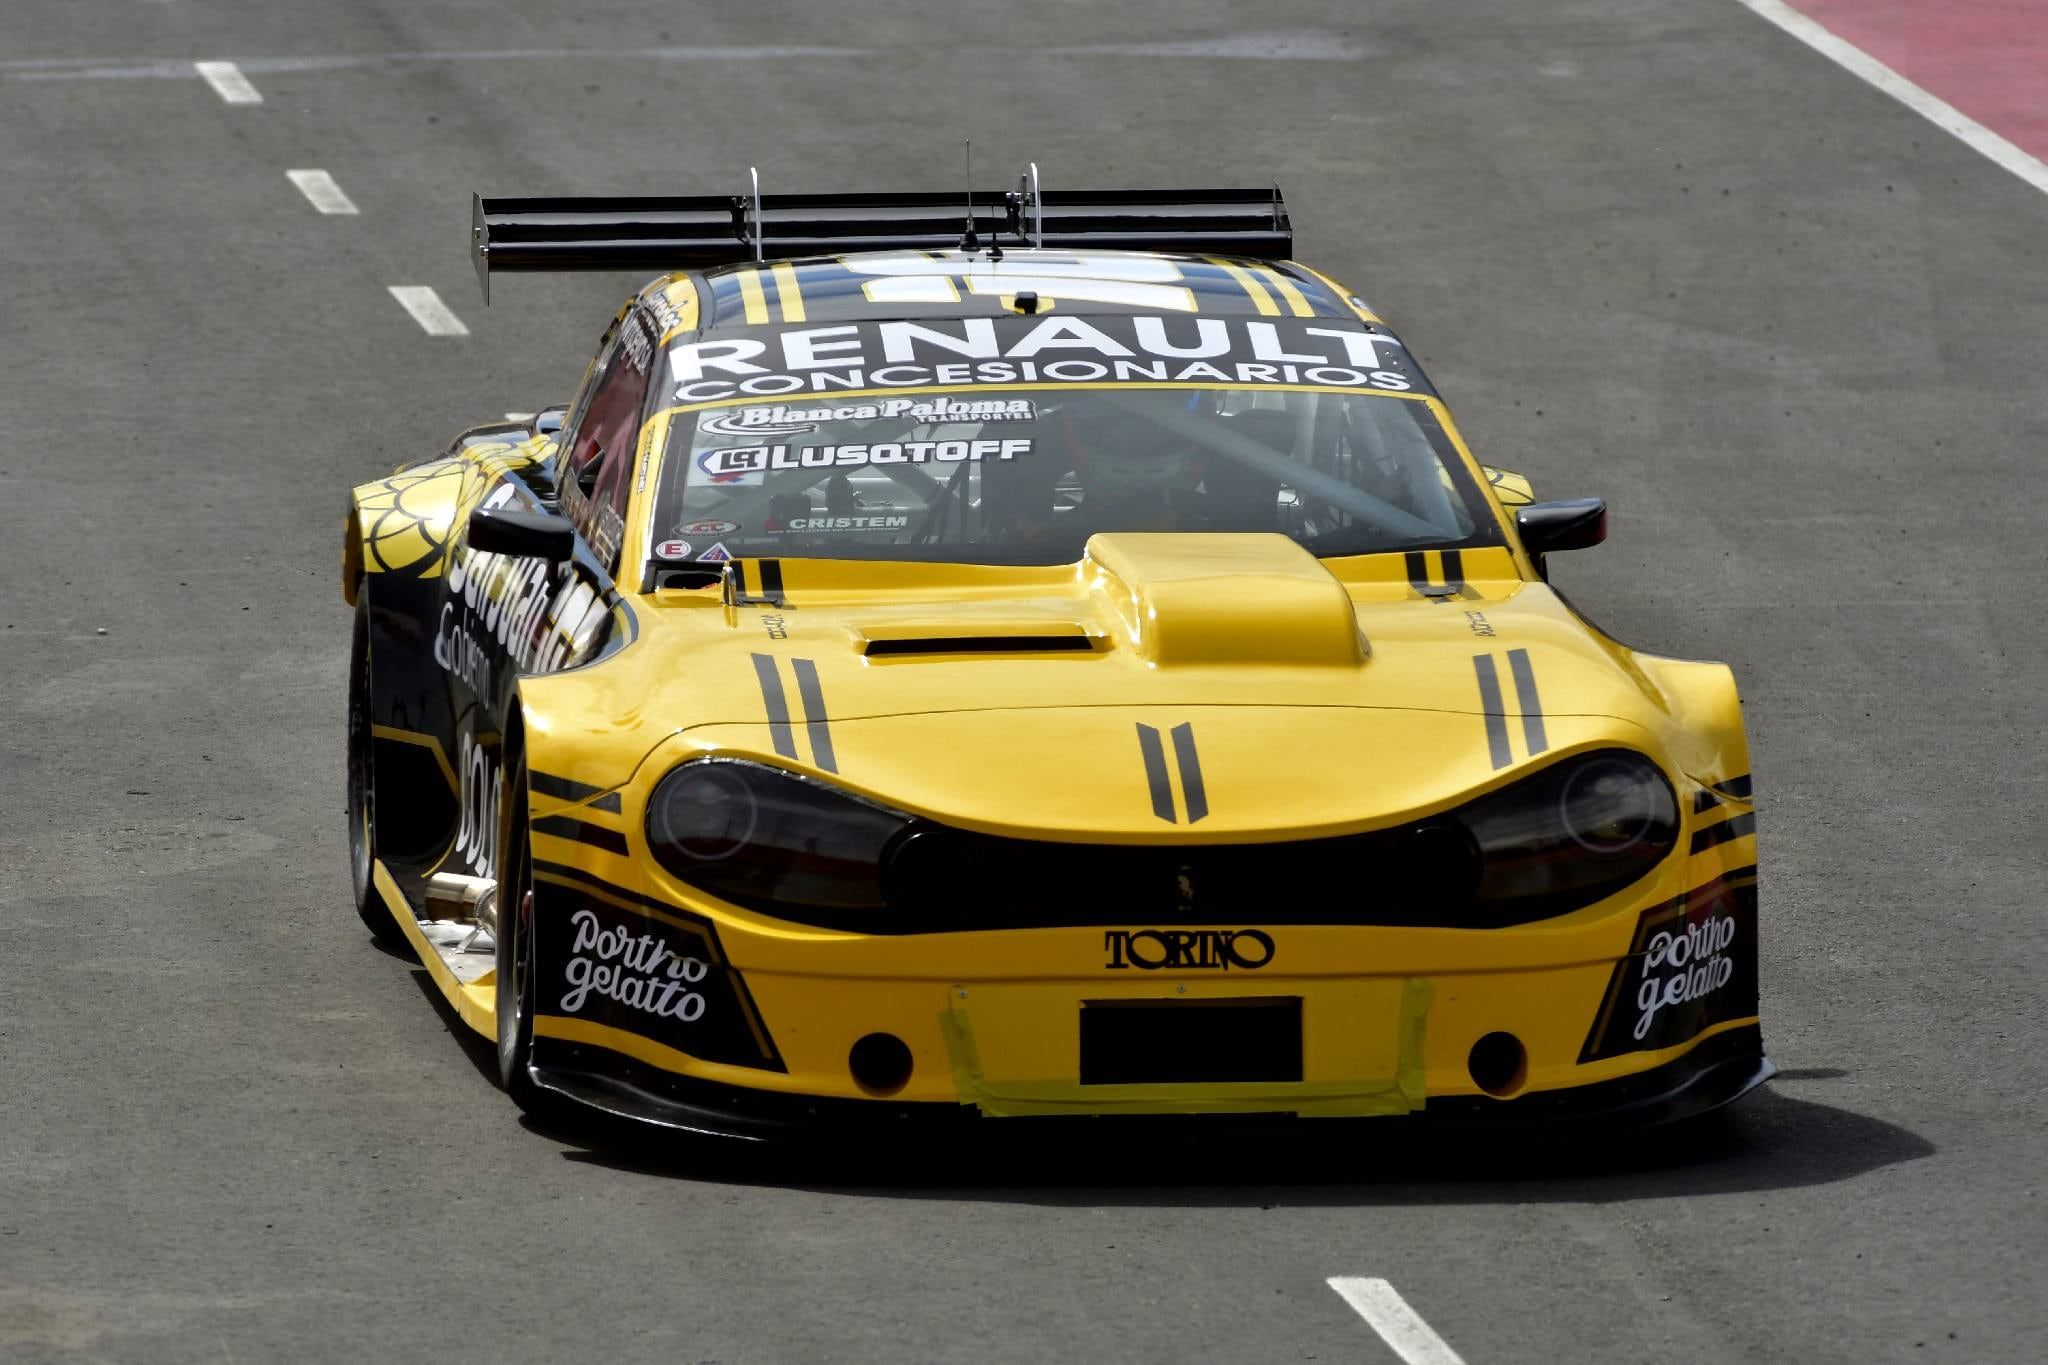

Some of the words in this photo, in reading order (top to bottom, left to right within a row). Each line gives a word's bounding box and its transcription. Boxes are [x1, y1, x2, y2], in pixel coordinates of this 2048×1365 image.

[669, 315, 1402, 382] RENAULT
[674, 357, 1411, 401] CONCESIONARIOS
[741, 404, 878, 427] Blanca
[882, 397, 1031, 418] Paloma
[918, 411, 1034, 423] TRANSPORTES
[771, 438, 1031, 470] LUSQTOFF
[788, 516, 908, 529] CRISTEM
[664, 543, 683, 555] E
[1104, 928, 1276, 971] TORINO
[560, 957, 706, 1022] gelatto
[1633, 954, 1733, 1041] gelatto
